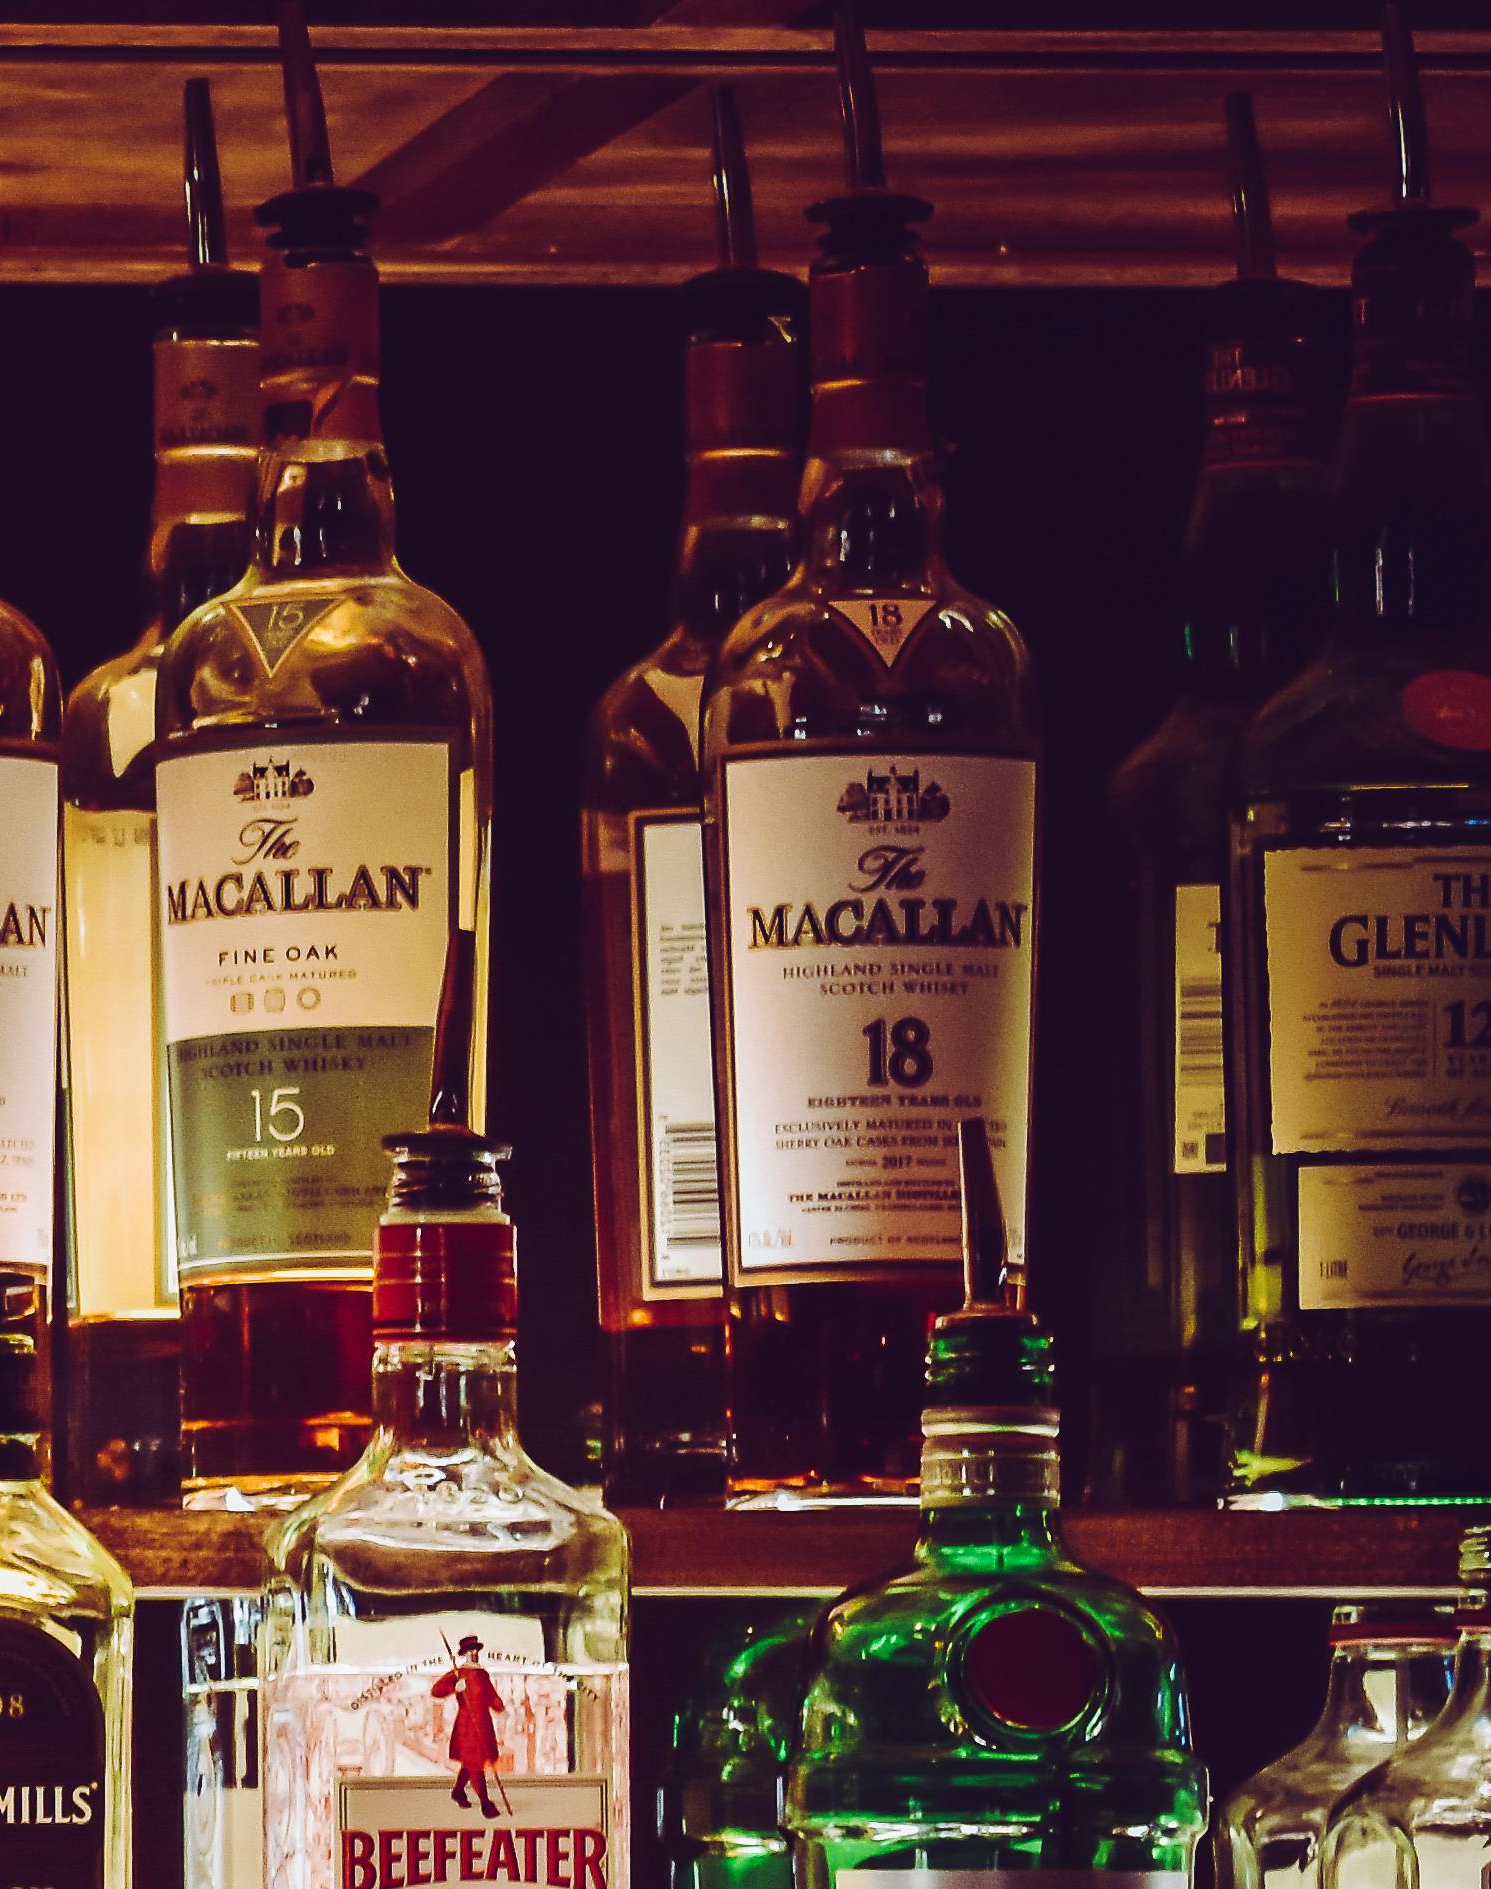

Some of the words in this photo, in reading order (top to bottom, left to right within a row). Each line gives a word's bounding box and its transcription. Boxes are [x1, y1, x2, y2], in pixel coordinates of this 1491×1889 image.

[267, 603, 302, 629] 15
[869, 602, 904, 629] 18
[231, 818, 301, 866] The
[849, 845, 926, 892] The
[167, 865, 424, 926] MACALLAN
[748, 898, 1025, 949] MACALLAN
[1329, 914, 1491, 967] GLENL
[218, 949, 274, 967] FINE
[286, 945, 339, 962] OAK
[289, 970, 356, 980] MATURED
[783, 962, 881, 979] HIGHLAND
[891, 962, 955, 977] SINGLE
[820, 981, 894, 995] SCOTCH
[904, 981, 967, 994] WHISKY
[268, 1035, 347, 1053] SINGLE
[358, 1035, 410, 1050] MALT
[862, 1016, 933, 1087] 18
[200, 1060, 272, 1078] SCOTCH
[284, 1056, 367, 1075] WHISKY
[807, 1096, 890, 1109] EIGHTEEN
[252, 1086, 305, 1143] 15
[775, 1119, 861, 1134] EXCLUSIVELY
[867, 1118, 933, 1131] MATURED
[227, 1147, 268, 1160] FIFTEEN
[273, 1146, 309, 1158] YEARS
[312, 1145, 334, 1156] OLD
[883, 1154, 912, 1167] 2017
[1397, 1222, 1460, 1239] GEORGE
[488, 1652, 526, 1665] HEART
